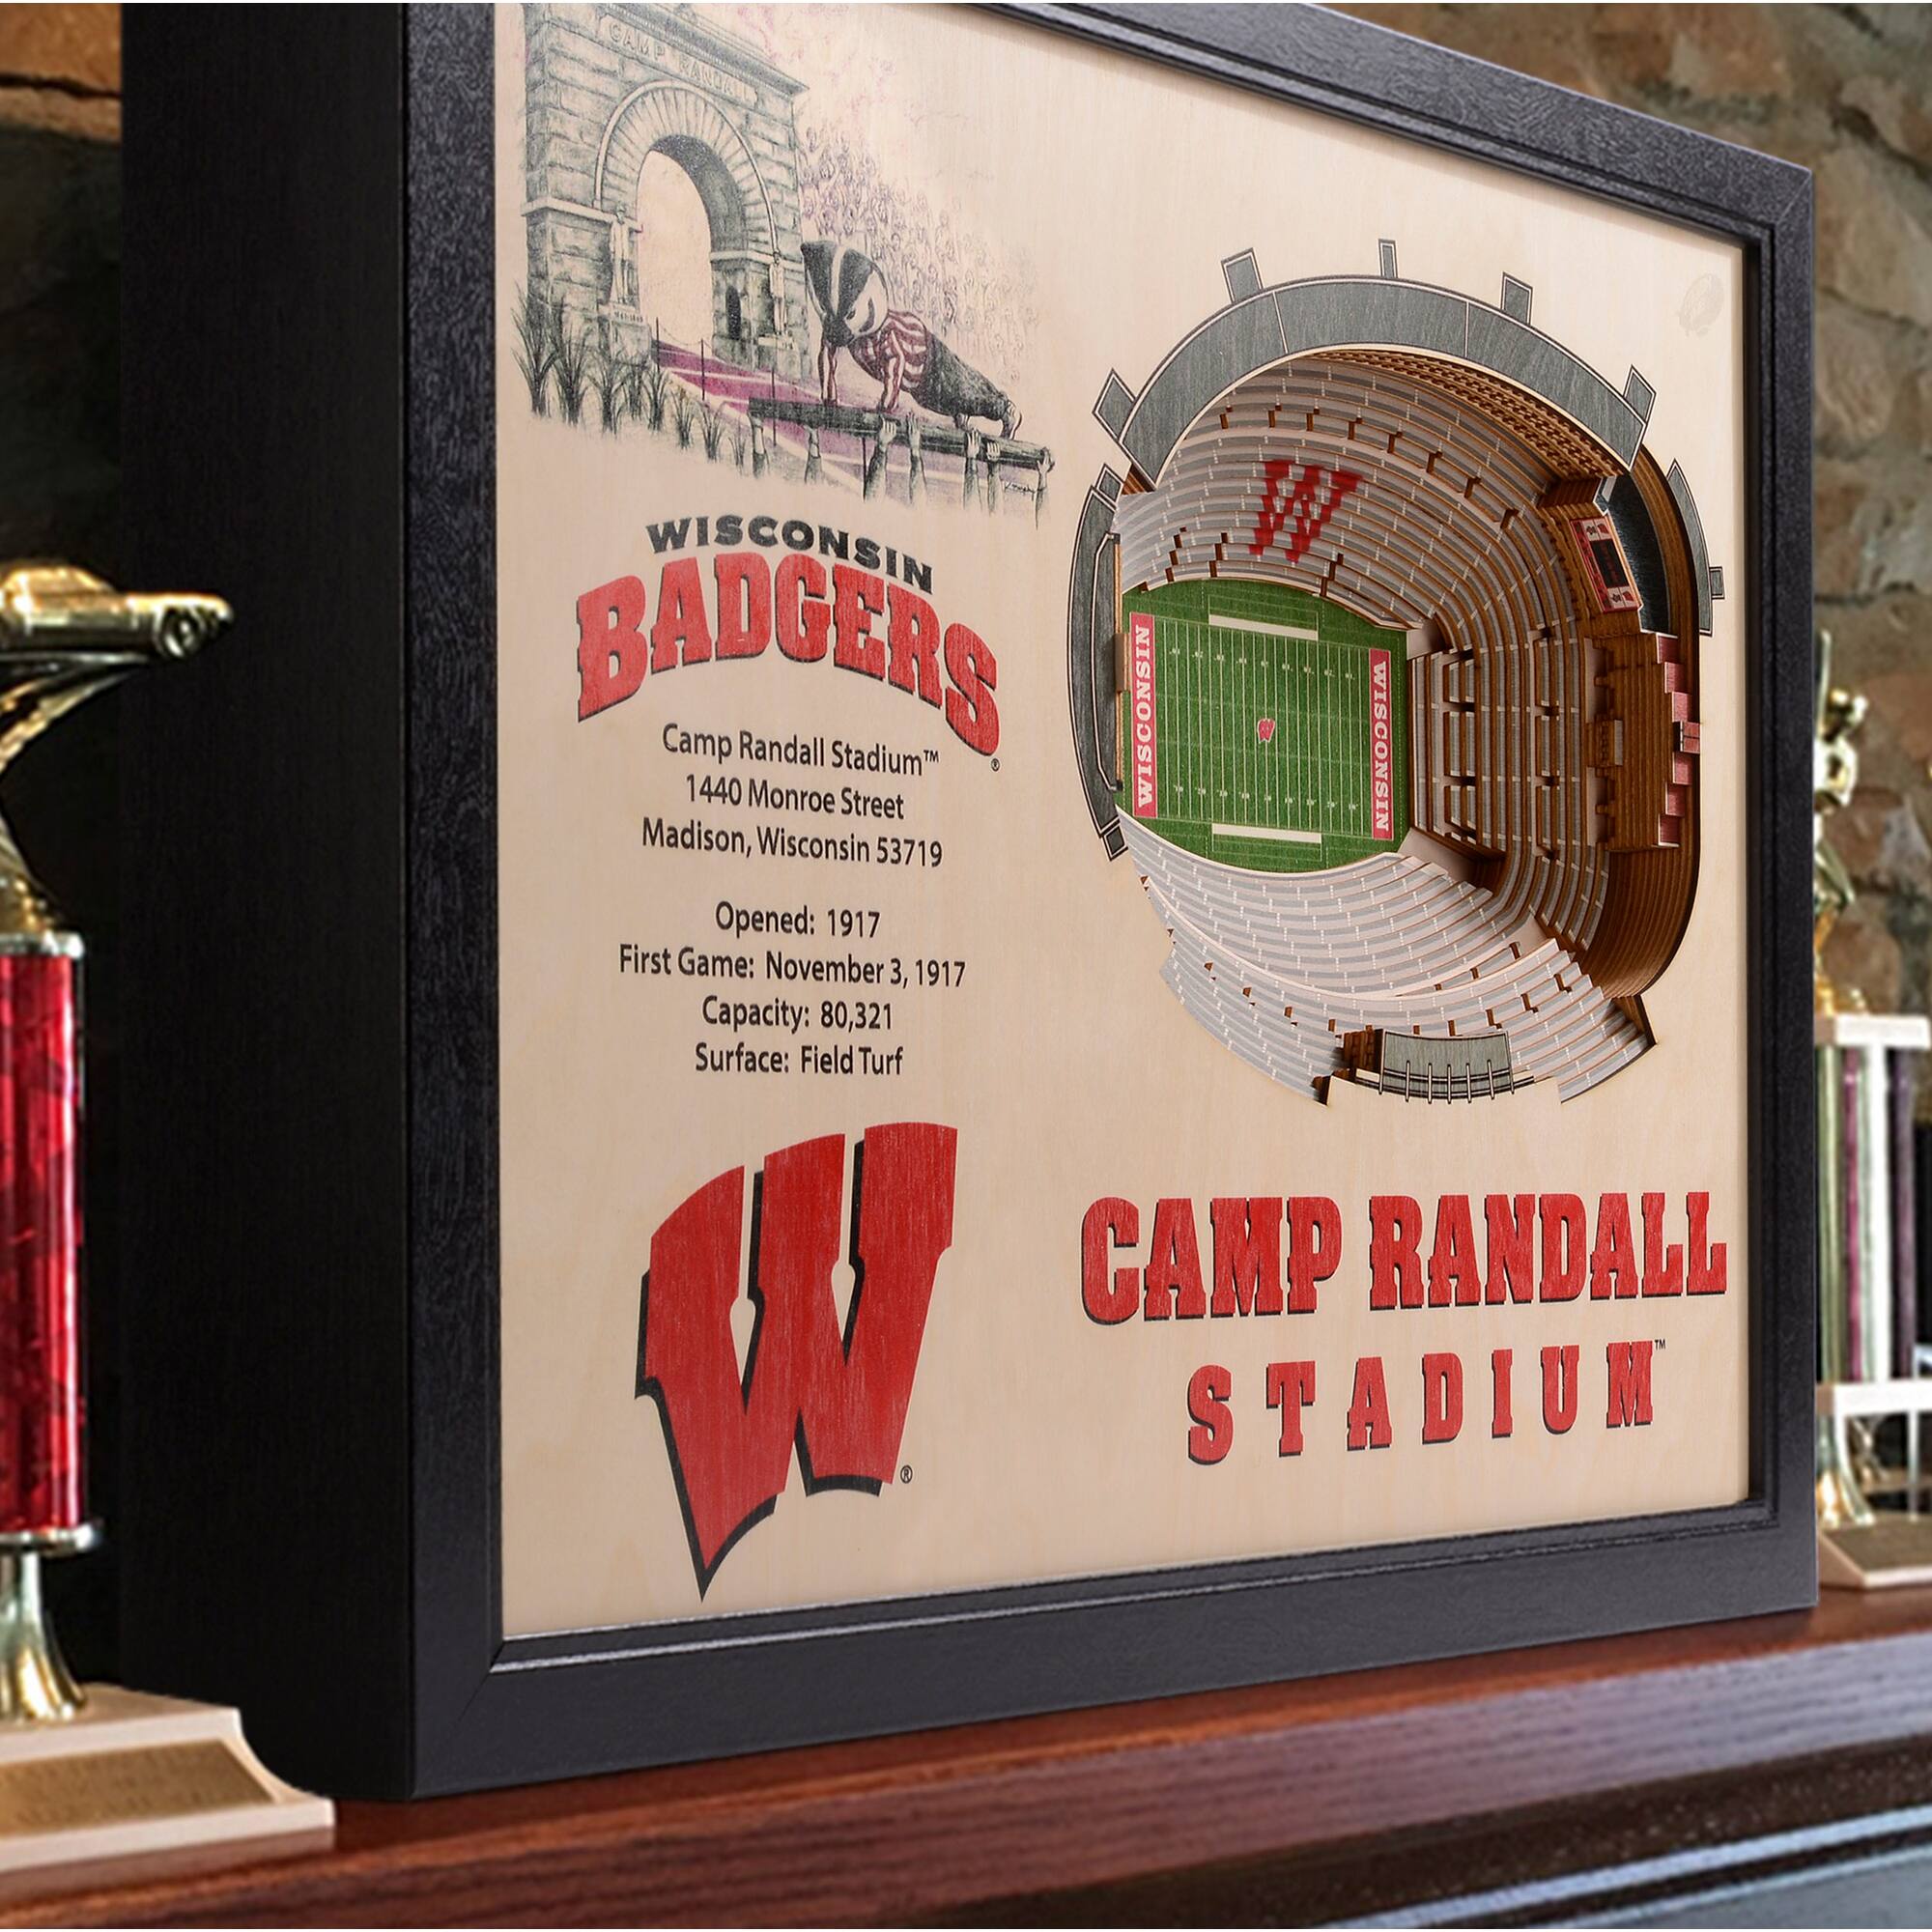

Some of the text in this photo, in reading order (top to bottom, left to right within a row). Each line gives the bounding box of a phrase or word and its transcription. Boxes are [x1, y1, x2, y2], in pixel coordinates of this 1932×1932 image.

[610, 24, 666, 60] CAMP
[646, 515, 933, 594] WISCONSIN
[1135, 624, 1153, 808] WISCONSIN
[663, 724, 732, 764] Camp
[740, 729, 824, 766] Randall
[1373, 661, 1389, 832] WISCONSIN
[687, 775, 904, 819] 1440 Monroe Street
[642, 817, 942, 867] Madison, Wisconsin 53719
[716, 901, 880, 940] Opened: 1917
[620, 944, 965, 989] First Game: November 3, 1917
[703, 995, 892, 1035] Capacity: 80,321
[696, 1042, 788, 1073] Surface:
[1081, 1192, 1727, 1325] CAMP RANDALL
[634, 1122, 958, 1603] W
